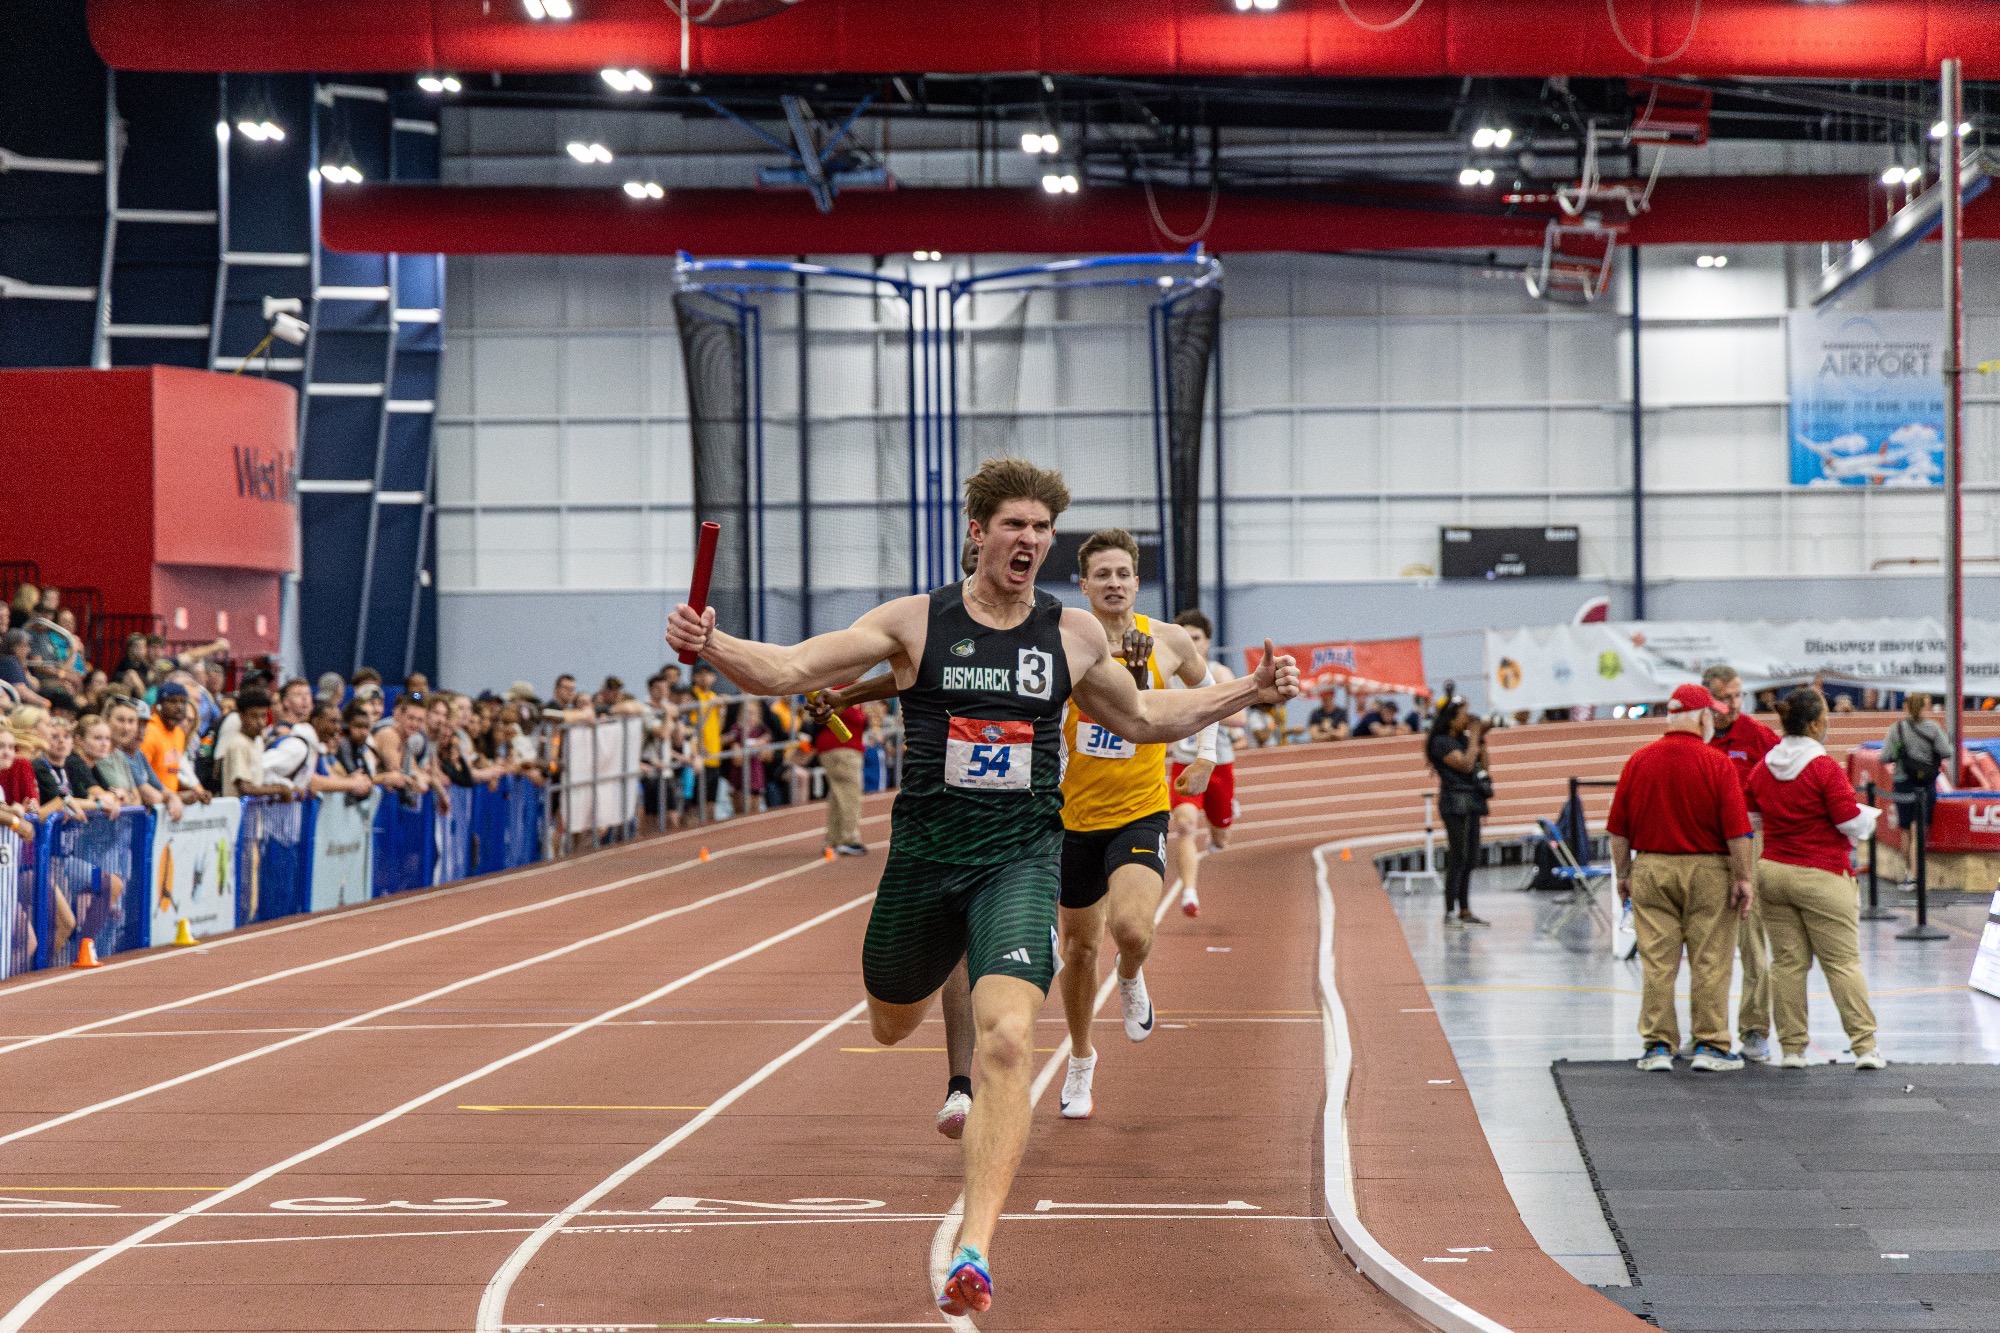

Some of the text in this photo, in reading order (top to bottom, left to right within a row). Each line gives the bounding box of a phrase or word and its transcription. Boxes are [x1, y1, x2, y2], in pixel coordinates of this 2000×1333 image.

[1819, 350, 1931, 377] AIRPORT
[942, 667, 1011, 692] BISMARCK
[1023, 654, 1046, 694] 3
[1088, 725, 1123, 751] 312
[967, 745, 1011, 777] 54
